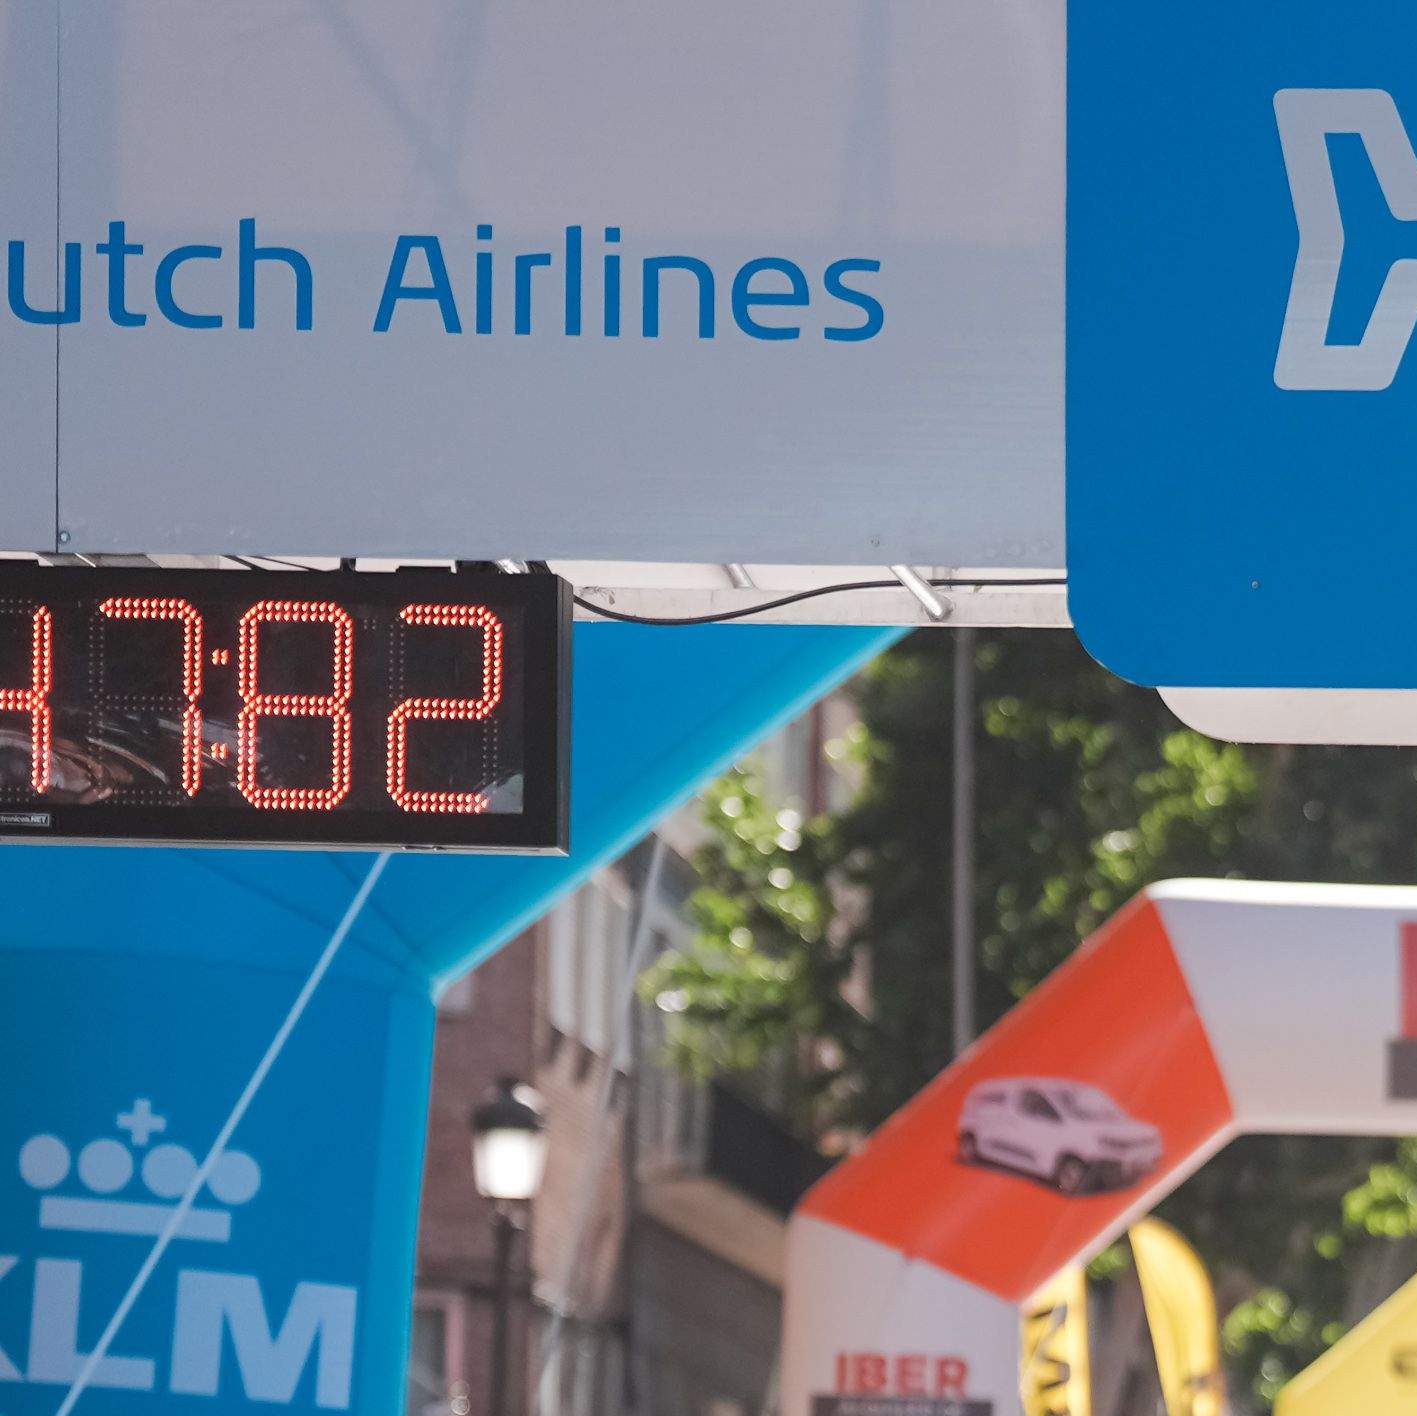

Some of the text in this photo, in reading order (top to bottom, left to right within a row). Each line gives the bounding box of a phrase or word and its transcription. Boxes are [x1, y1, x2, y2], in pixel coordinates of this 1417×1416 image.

[373, 223, 885, 342] Airlines
[0, 1254, 357, 1409] LM
[835, 1352, 969, 1398] IBER
